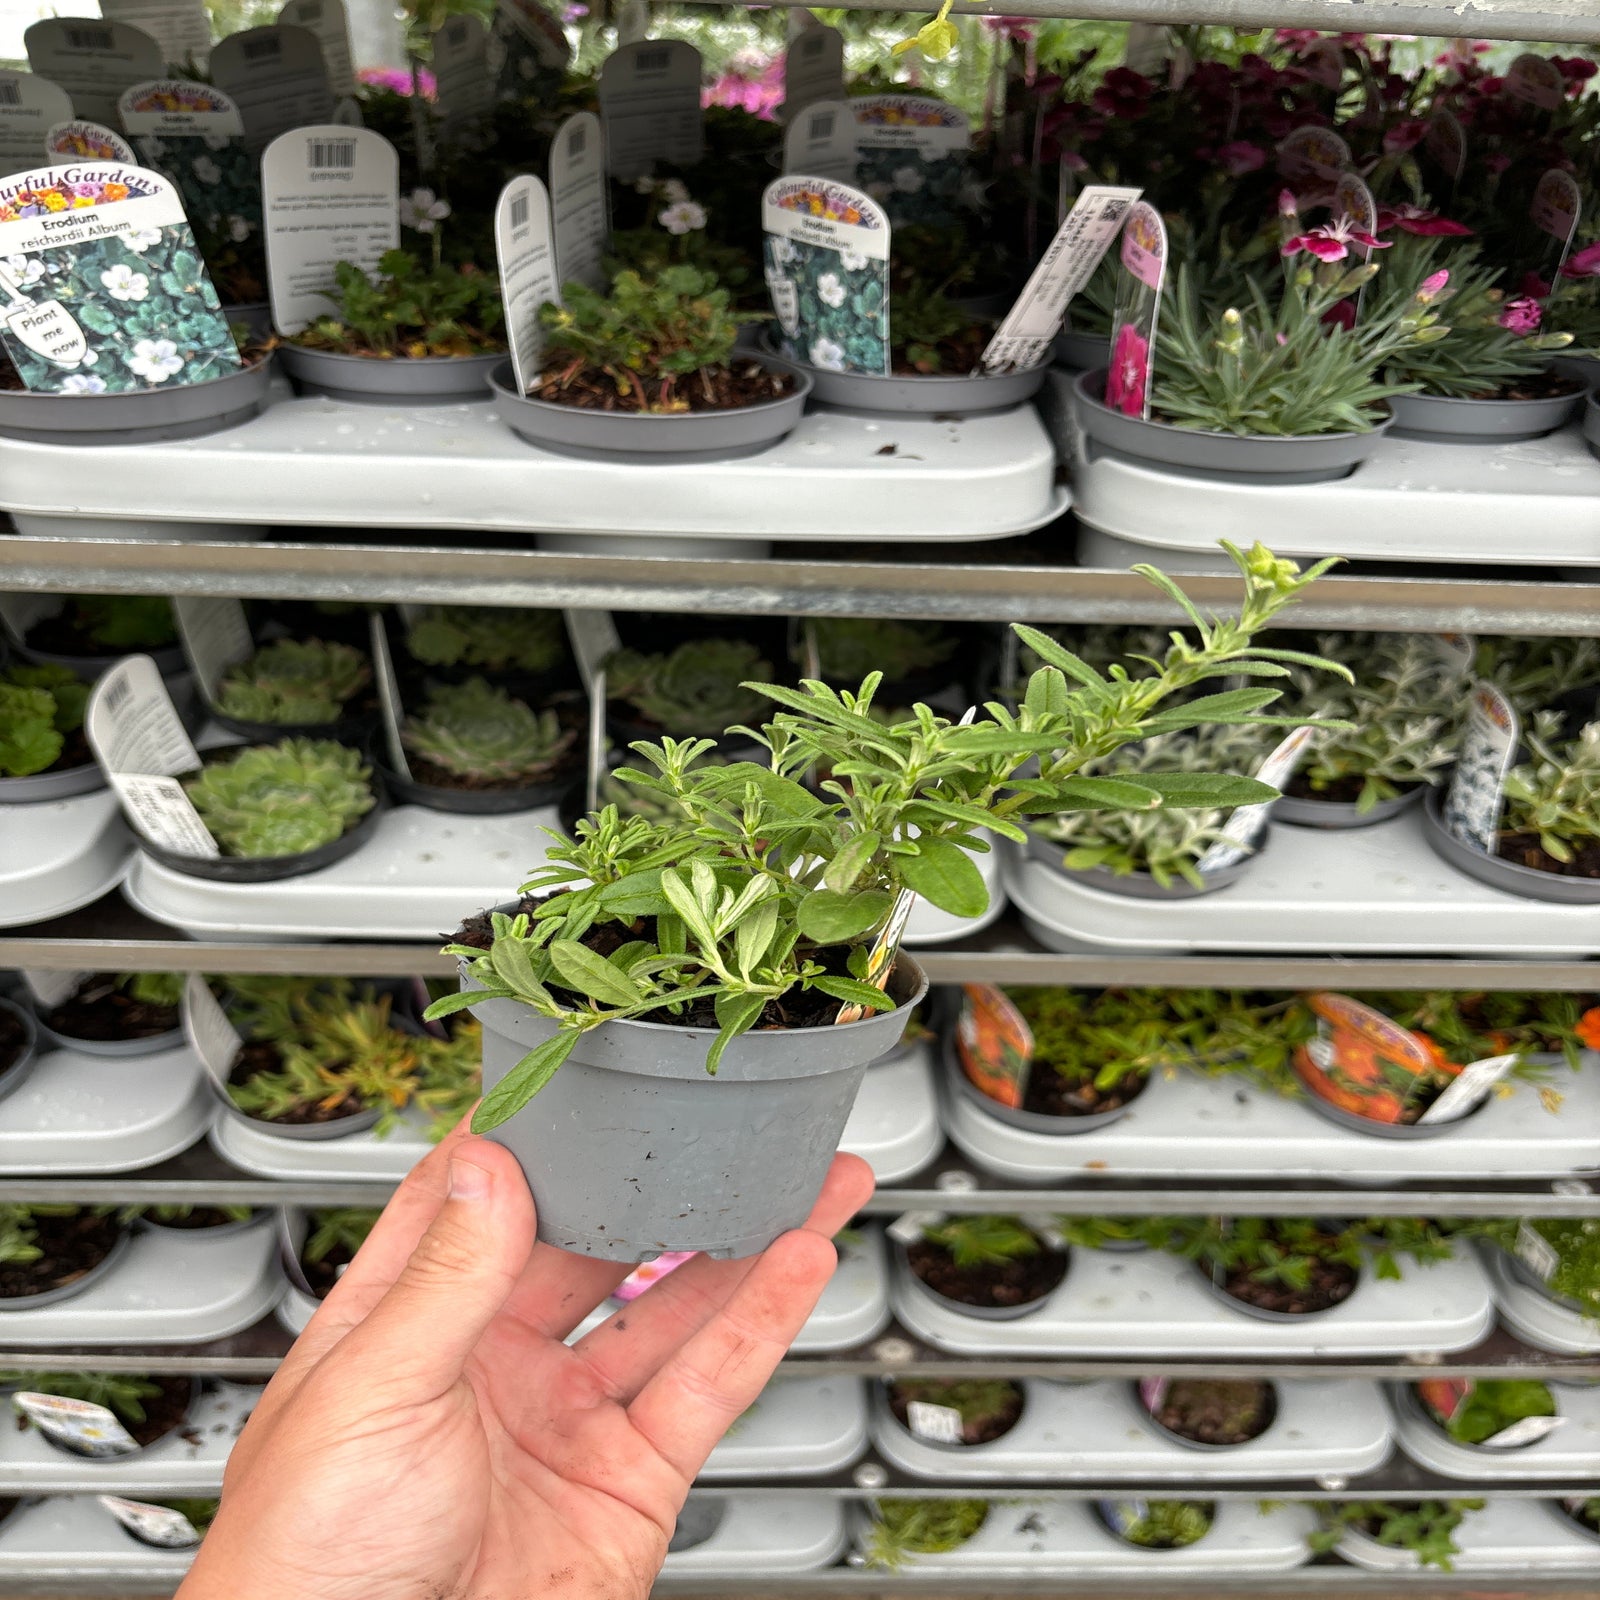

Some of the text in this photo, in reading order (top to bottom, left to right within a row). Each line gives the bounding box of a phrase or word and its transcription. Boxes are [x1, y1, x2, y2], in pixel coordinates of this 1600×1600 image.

[64, 167, 163, 195] Gardens
[42, 213, 99, 231] Erodium
[21, 221, 132, 249] reichardii Album
[21, 309, 58, 331] Plant
[42, 327, 64, 341] me
[51, 339, 79, 356] now
